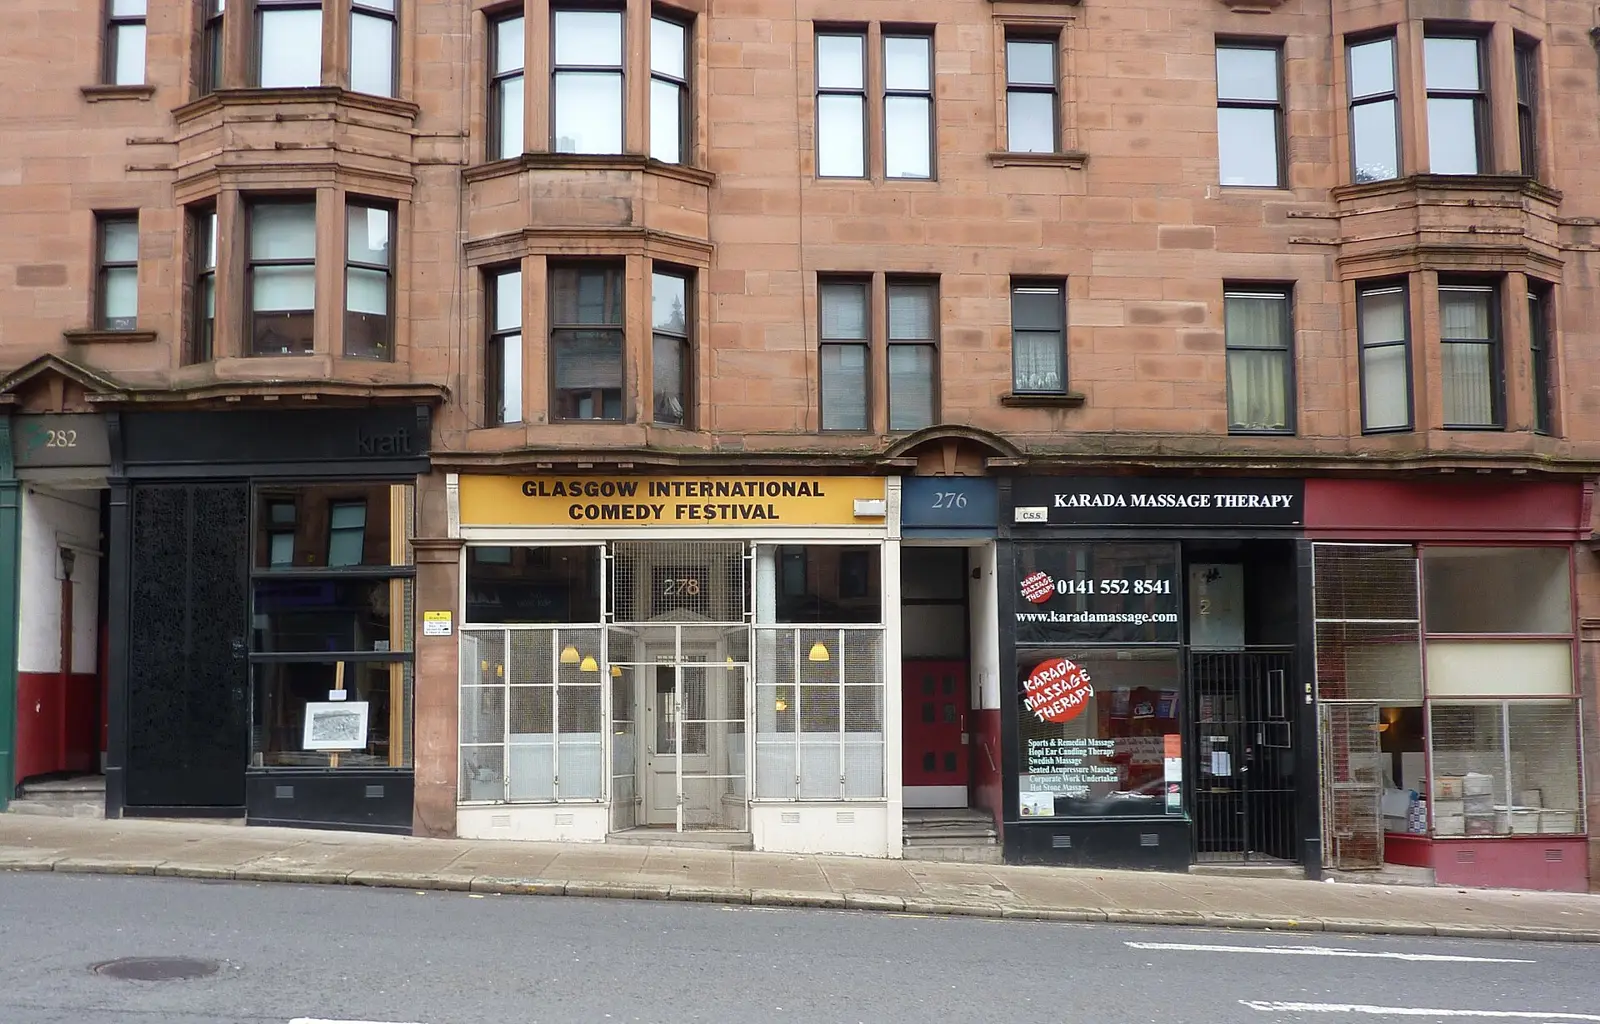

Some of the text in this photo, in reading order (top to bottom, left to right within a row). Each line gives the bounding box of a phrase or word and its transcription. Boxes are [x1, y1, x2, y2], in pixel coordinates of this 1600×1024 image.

[47, 430, 77, 447] 282
[357, 426, 411, 453] kraft
[522, 480, 825, 498] GLASGOW INTERNATIONAL
[931, 491, 968, 509] 276
[1053, 493, 1294, 508] KARADA MASSAGE THERAPY
[568, 503, 780, 520] COMEDY FESTIVAL
[663, 578, 700, 595] 278
[1020, 571, 1047, 587] KARADA
[1020, 575, 1054, 597] MASSAGE
[1056, 579, 1171, 595] 0141 552 8541
[1025, 583, 1056, 602] THERAPY
[1015, 610, 1178, 626] www.karadamassage.com
[1023, 659, 1077, 693] KARADA
[1023, 669, 1091, 711] MASSAGE
[1034, 685, 1095, 723] THERAPY
[1028, 738, 1049, 750] Sports
[1050, 738, 1056, 747] &
[1058, 738, 1087, 747] Remedial
[1088, 739, 1115, 749] Massage
[1028, 747, 1115, 758] Hopi Ear Candling Therapy
[1028, 756, 1082, 767] Swedish Massage
[1028, 765, 1117, 775] Seated Acupressure Massage
[1029, 774, 1119, 785] Corporate Work Undertaken
[1030, 784, 1042, 792] Hot
[1043, 784, 1061, 792] Stone
